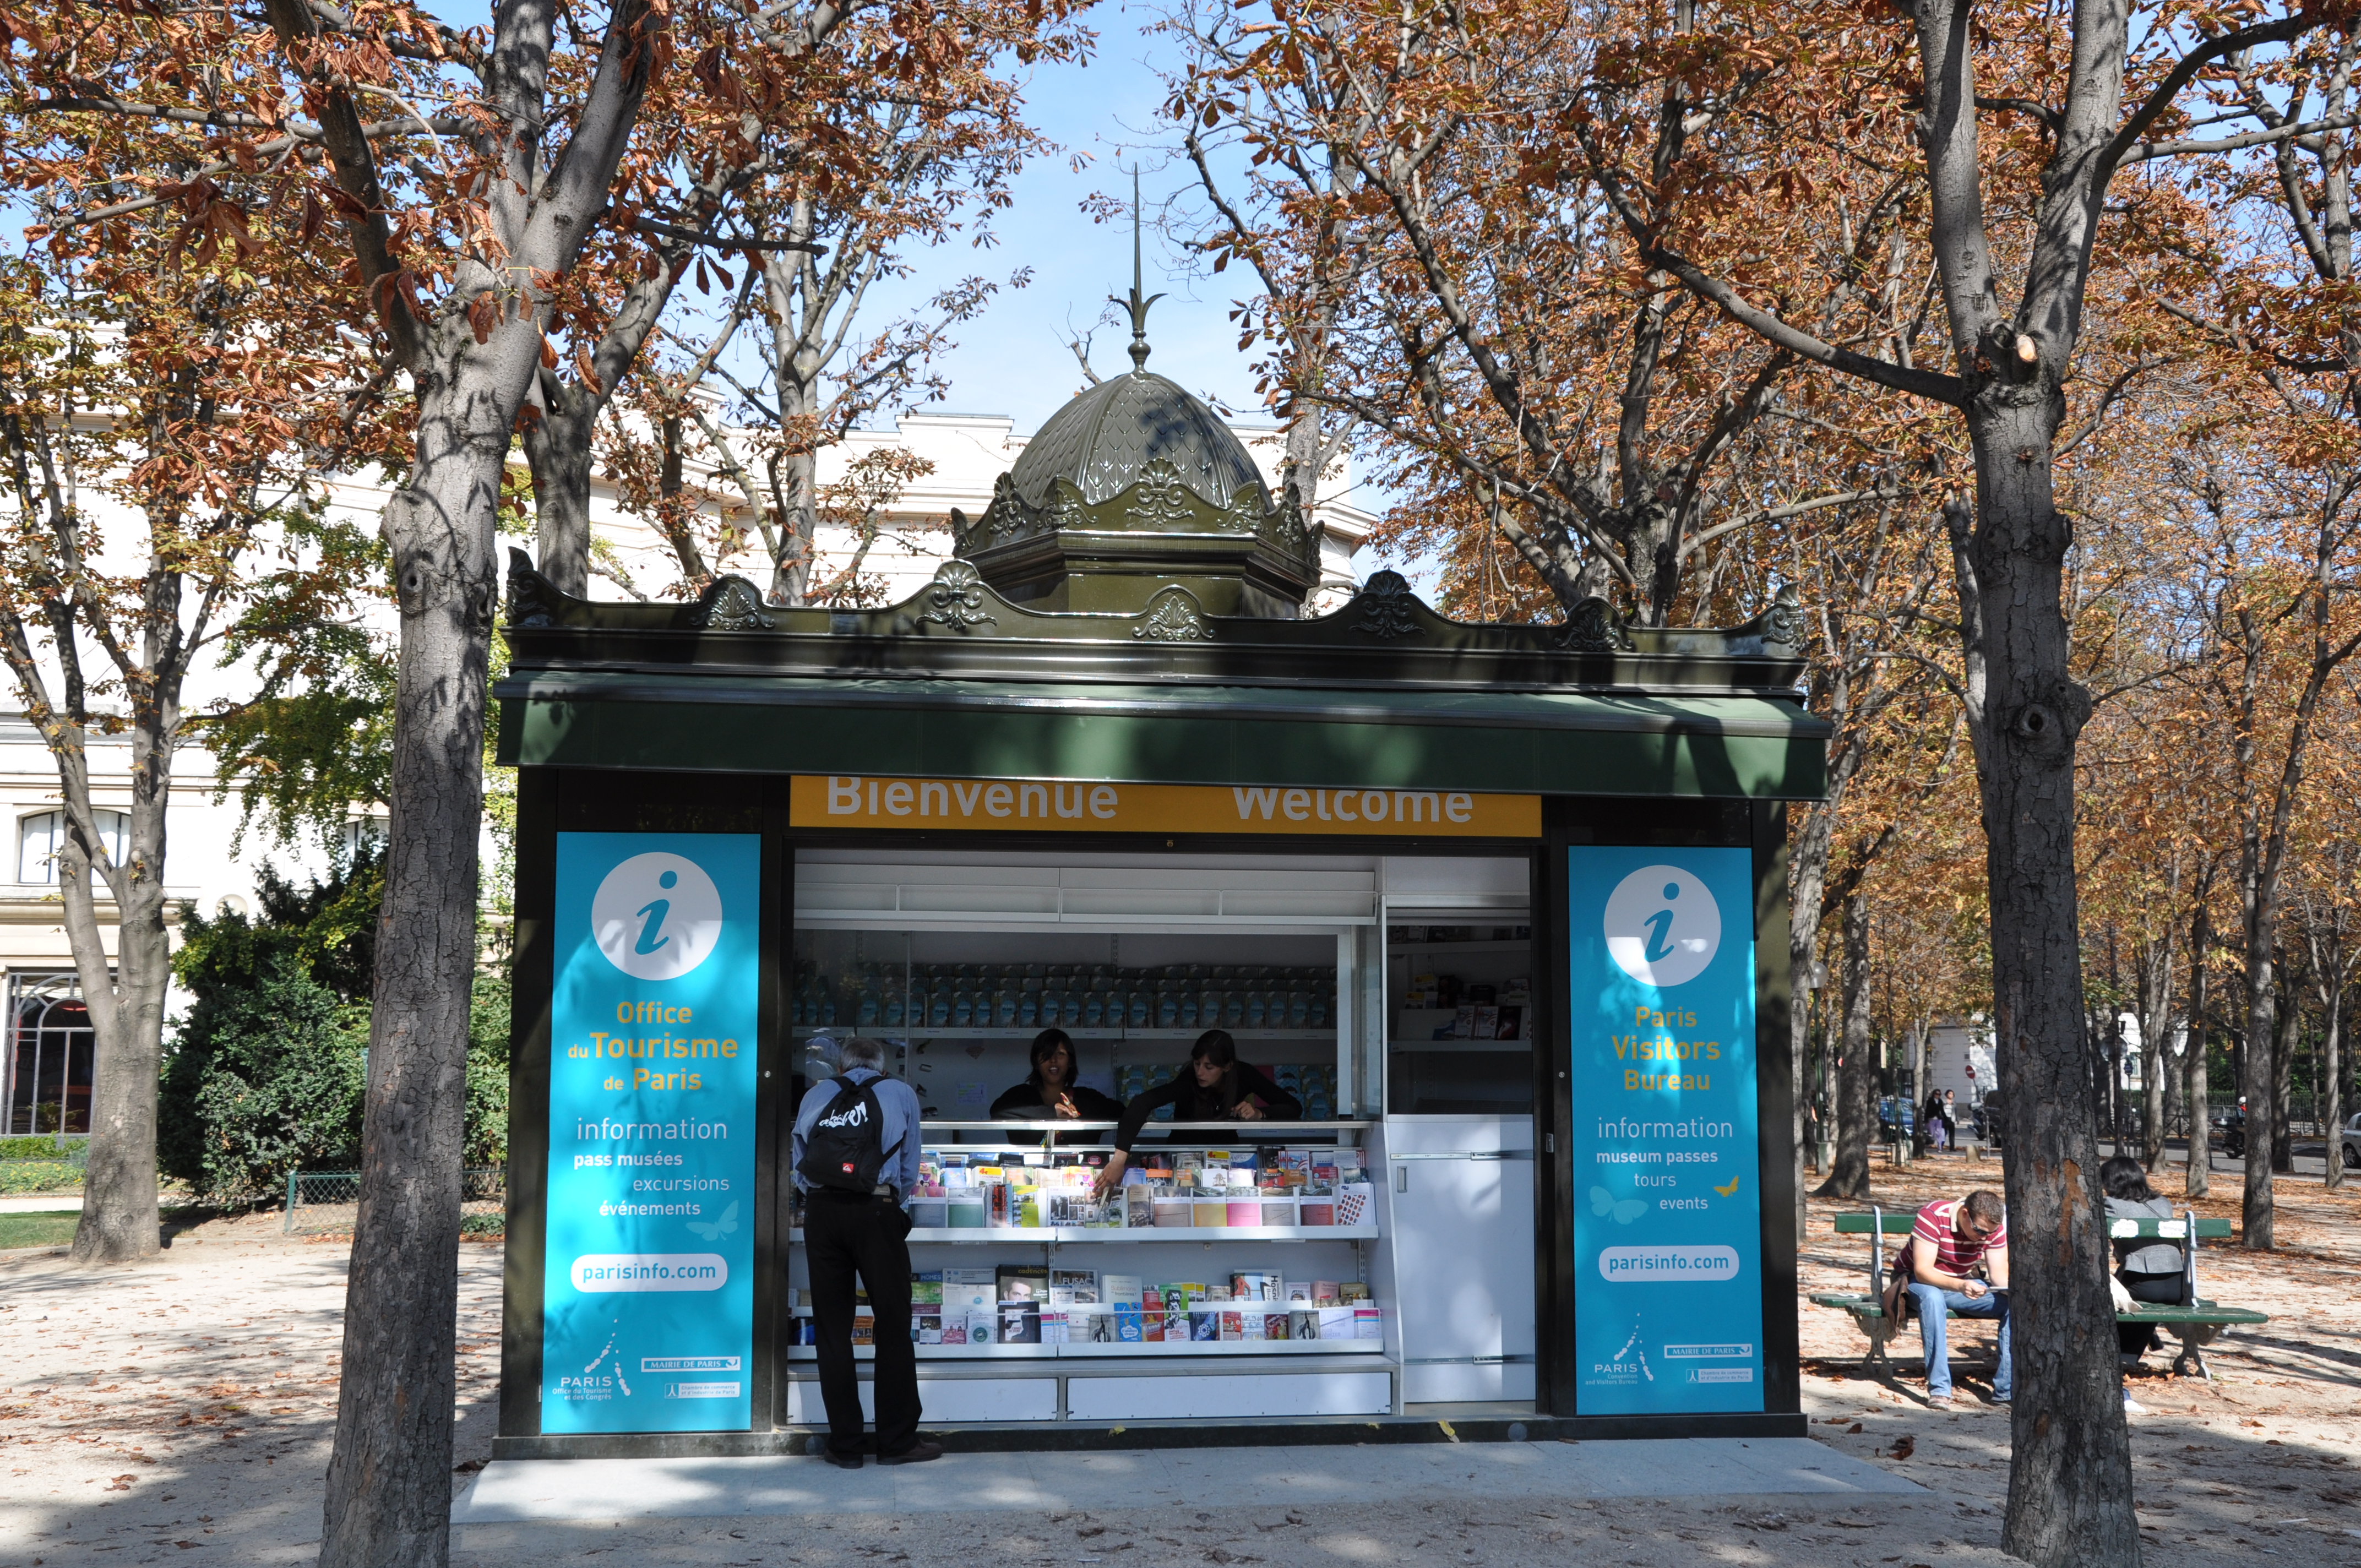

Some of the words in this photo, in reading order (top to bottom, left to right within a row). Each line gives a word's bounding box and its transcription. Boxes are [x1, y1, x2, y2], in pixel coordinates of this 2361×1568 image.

[828, 776, 1118, 819] Bienvenue
[1232, 787, 1473, 823] Welcome
[617, 1001, 692, 1023] Office
[1635, 1006, 1697, 1027] Paris
[568, 1044, 588, 1058] du
[590, 1032, 738, 1058] Tourisme
[1612, 1035, 1721, 1060] Visitors
[603, 1076, 623, 1090] de
[633, 1068, 702, 1090] Paris
[1624, 1070, 1710, 1090] Bureau
[577, 1118, 727, 1140] information
[1598, 1117, 1733, 1138] information
[574, 1154, 612, 1169] pass
[617, 1151, 683, 1166] musées
[1596, 1152, 1661, 1163] museum
[1667, 1151, 1718, 1166] passes
[633, 1175, 730, 1191] excursions
[1634, 1173, 1677, 1187] tours
[599, 1200, 701, 1216] événements
[1660, 1196, 1709, 1210] events
[583, 1263, 716, 1284] parisinfo.com
[1609, 1254, 1729, 1273] parisinfo.com
[1595, 1364, 1638, 1373] PARIS
[561, 1376, 612, 1387] PARIS
